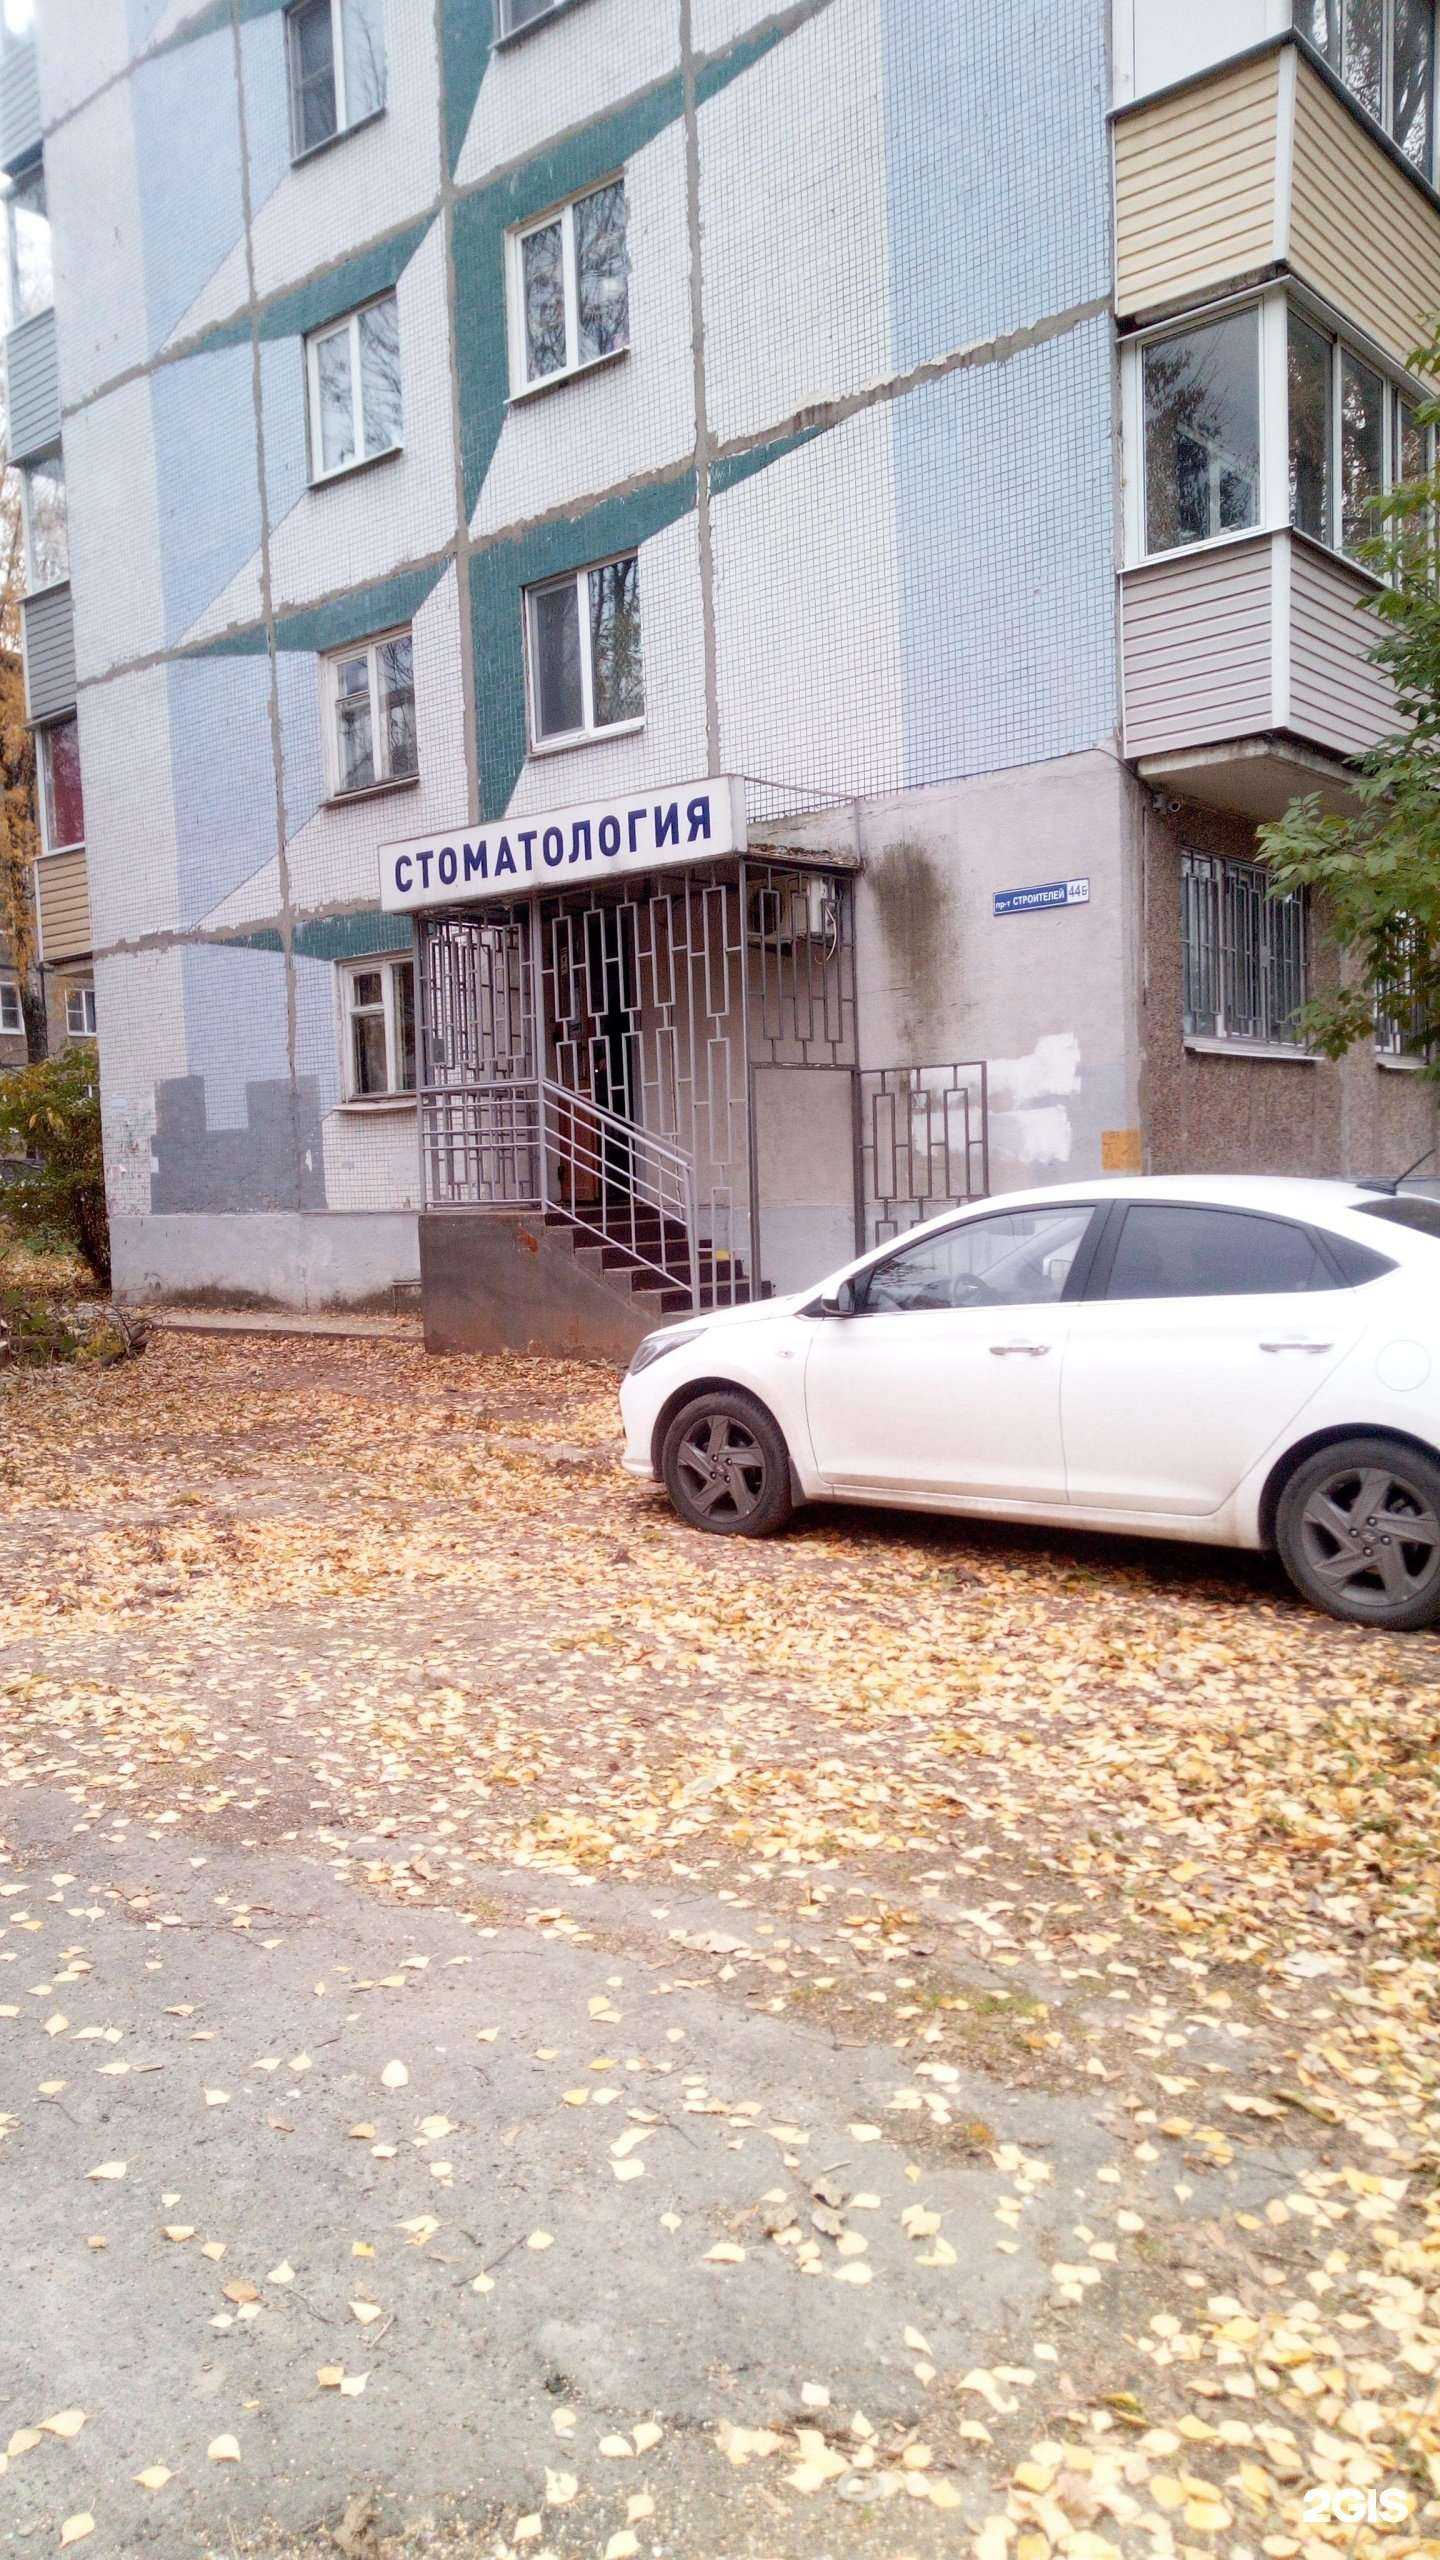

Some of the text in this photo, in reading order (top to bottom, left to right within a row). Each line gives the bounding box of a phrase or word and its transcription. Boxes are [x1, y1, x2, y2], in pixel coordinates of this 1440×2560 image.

[394, 795, 711, 893] СТОМАТОЛОГИЯ
[995, 901, 1010, 910] пр-т
[1012, 888, 1065, 906] СТРОИТЕЛЕЙ
